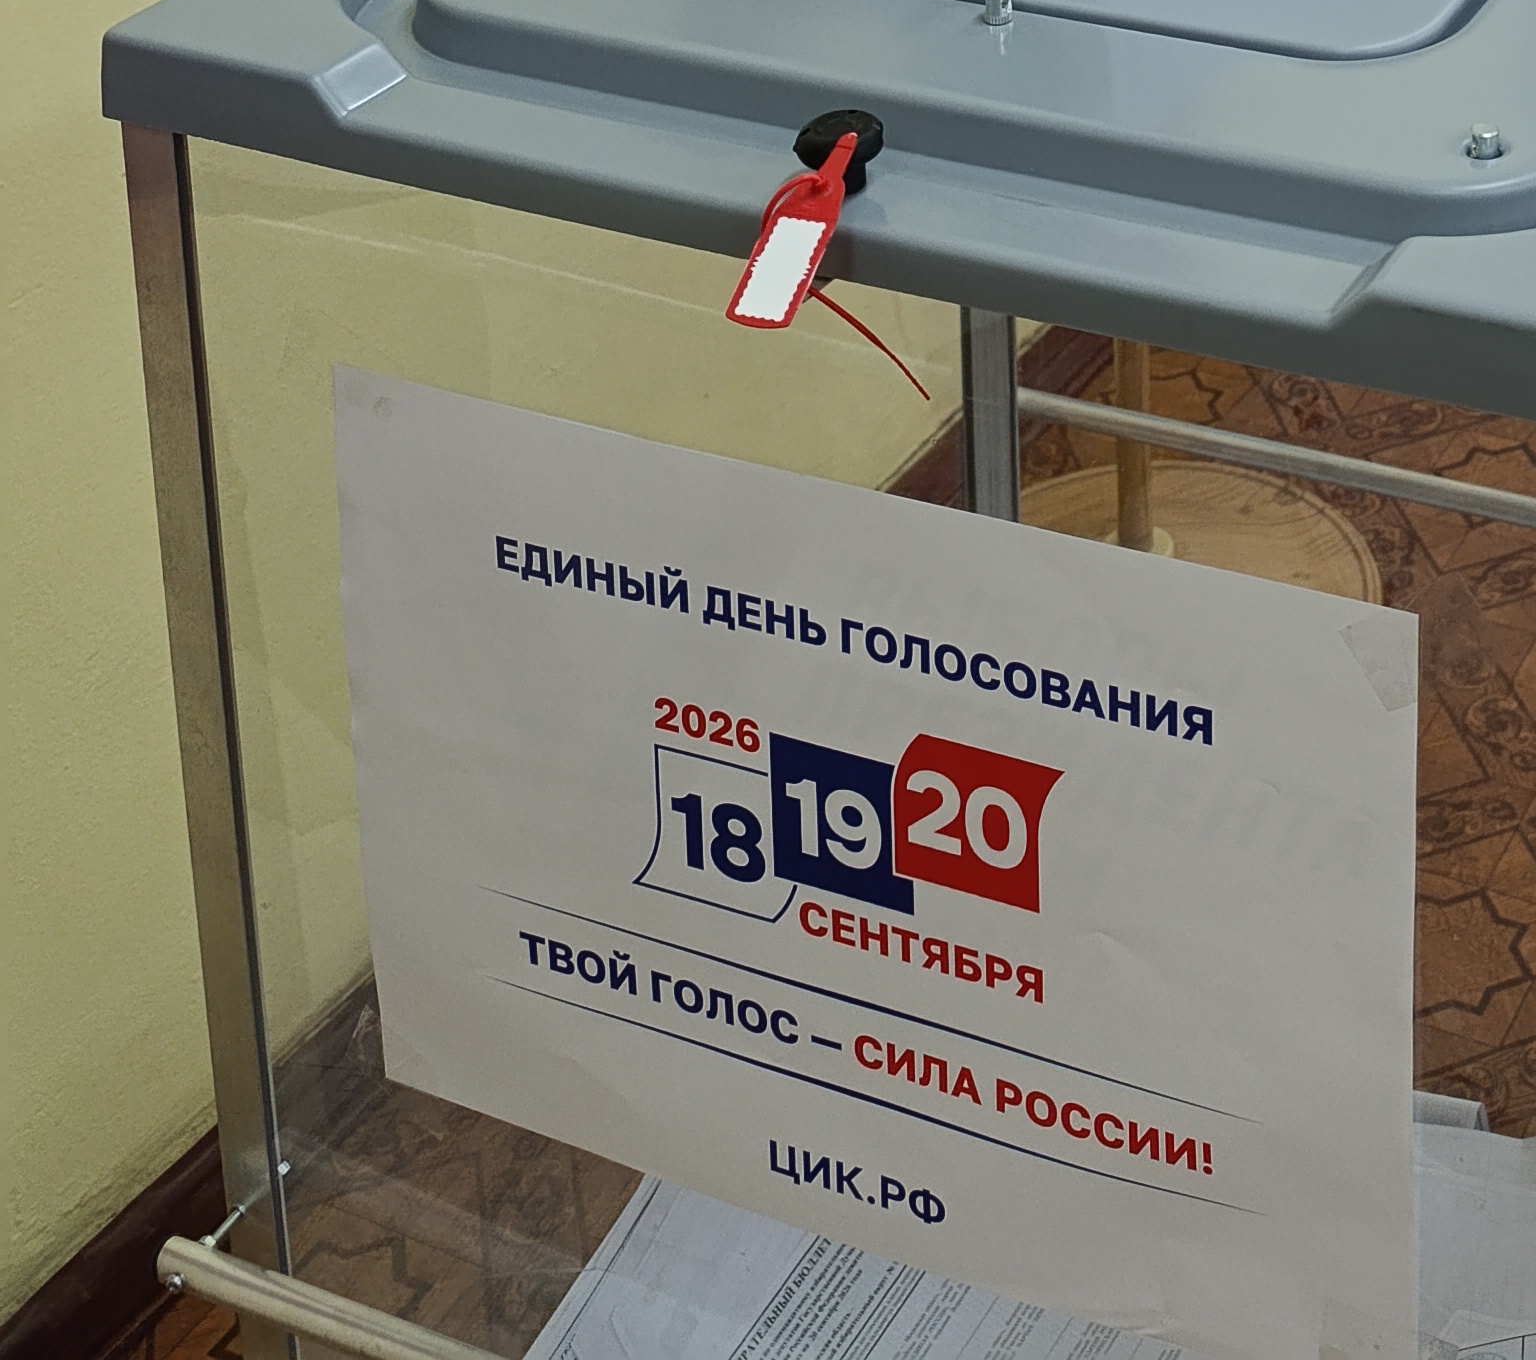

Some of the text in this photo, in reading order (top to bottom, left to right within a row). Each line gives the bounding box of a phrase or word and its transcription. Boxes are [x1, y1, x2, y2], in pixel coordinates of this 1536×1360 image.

[495, 535, 1213, 746] ЕДИНЫЙ ДЕНЬ ГОЛОСОВАНИЯ
[654, 697, 761, 753] 2026
[670, 769, 1028, 883] 18 19 20
[799, 901, 1044, 1004] СЕНТЯБРЯ
[518, 930, 638, 996] ТВОЙ
[650, 970, 799, 1045] ГОЛОС
[854, 1034, 982, 1106] СИЛА
[996, 1077, 1213, 1174] РОССИИ!
[769, 1139, 946, 1225] ЦИК.РФ
